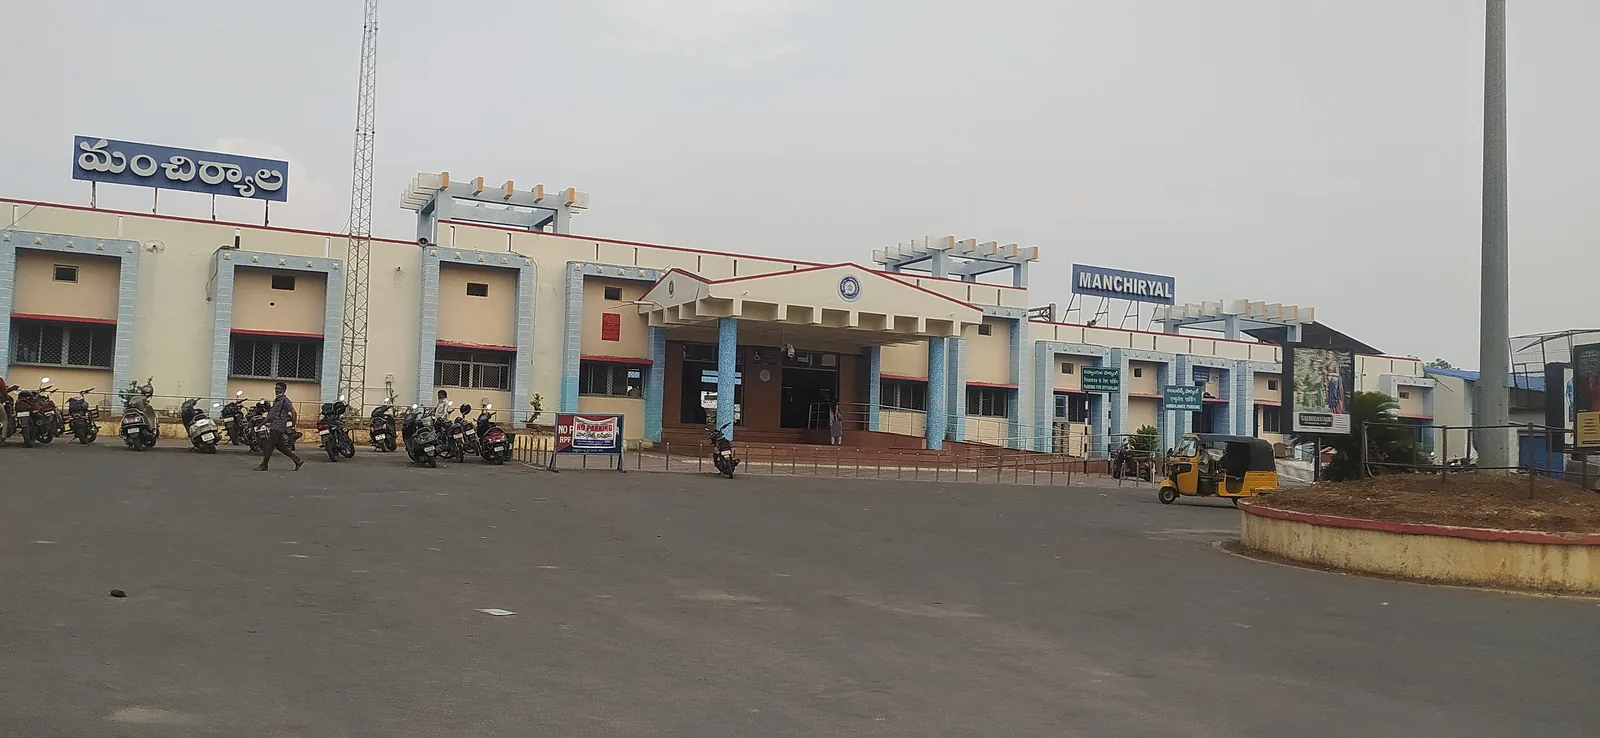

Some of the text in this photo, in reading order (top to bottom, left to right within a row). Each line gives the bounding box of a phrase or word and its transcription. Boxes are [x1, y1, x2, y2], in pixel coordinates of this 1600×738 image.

[78, 138, 284, 197] మంచిర్యాల
[1079, 271, 1173, 298] MANCHIRYAL
[558, 425, 568, 435] NO
[586, 424, 613, 432] PARKING
